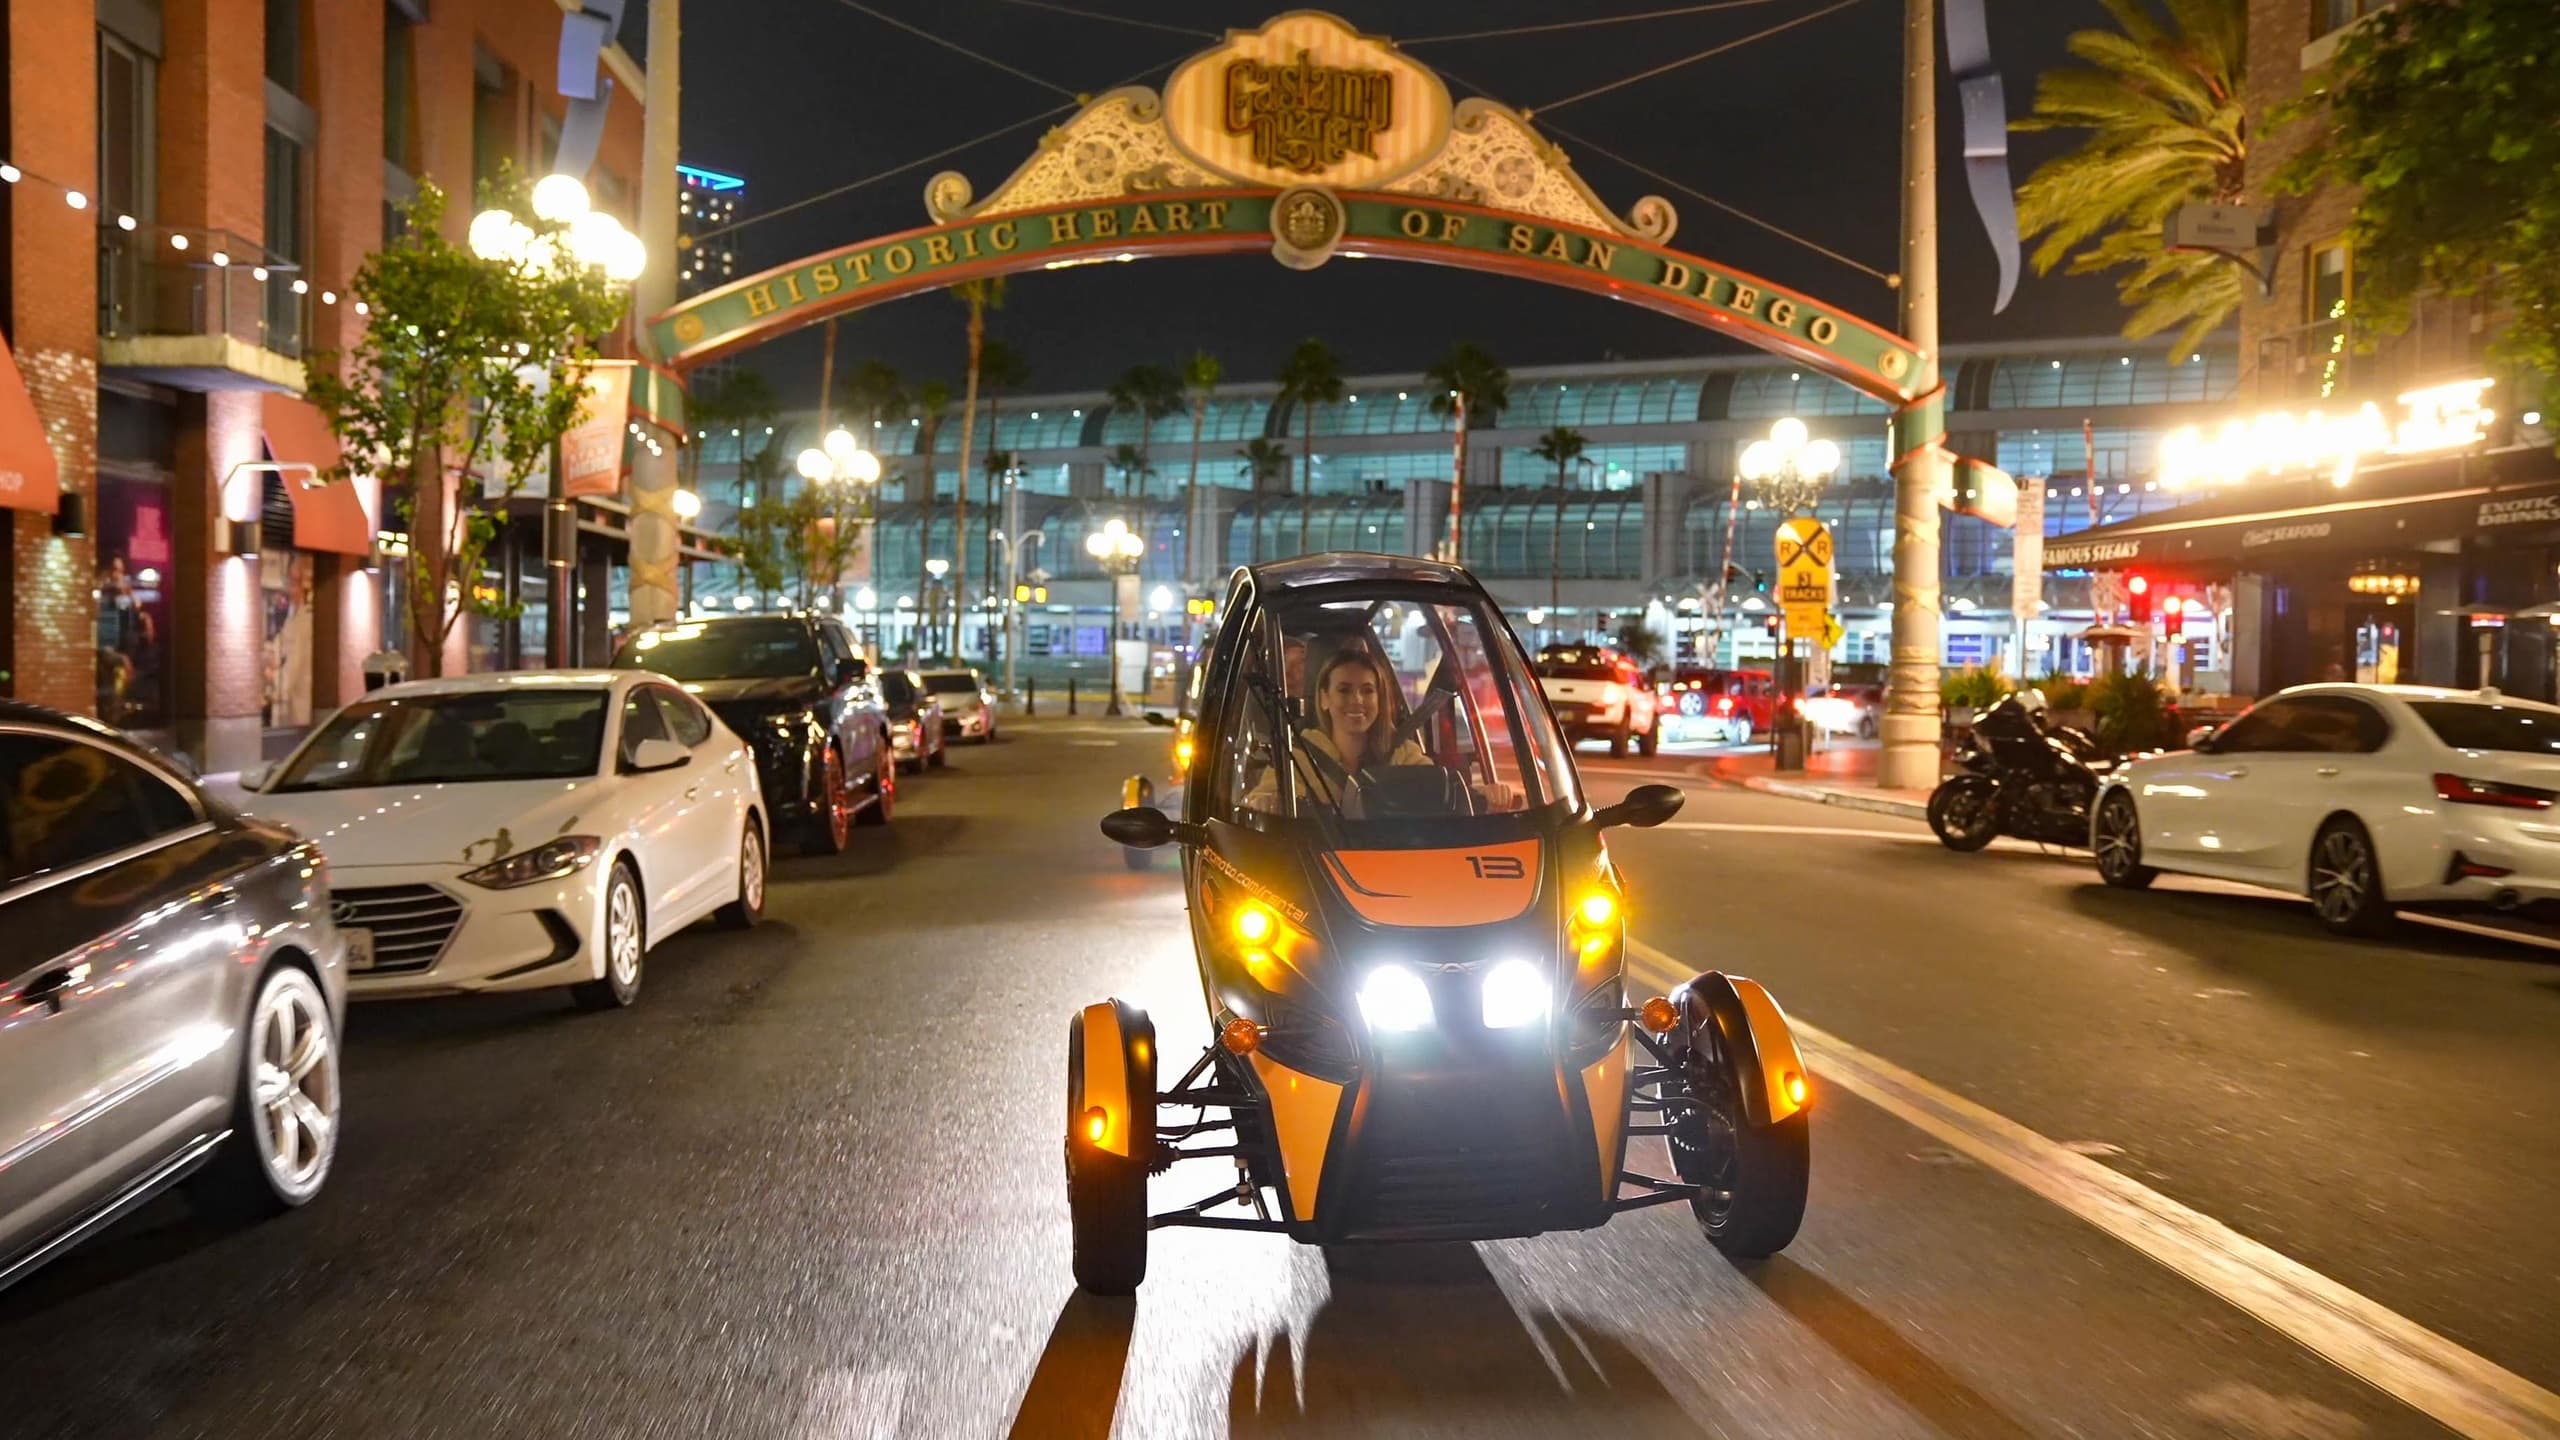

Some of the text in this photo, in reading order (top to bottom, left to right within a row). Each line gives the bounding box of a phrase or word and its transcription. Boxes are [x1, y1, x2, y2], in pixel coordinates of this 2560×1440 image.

[744, 201, 1839, 345] HISTORIC HEART OF SAN DIEGO
[2479, 495, 2560, 514] EXOTIC
[1780, 541, 1828, 554] R R
[2043, 540, 2141, 566] FAMOUS STEAKS
[1784, 588, 1825, 601] TRACKS
[1465, 856, 1525, 879] 13
